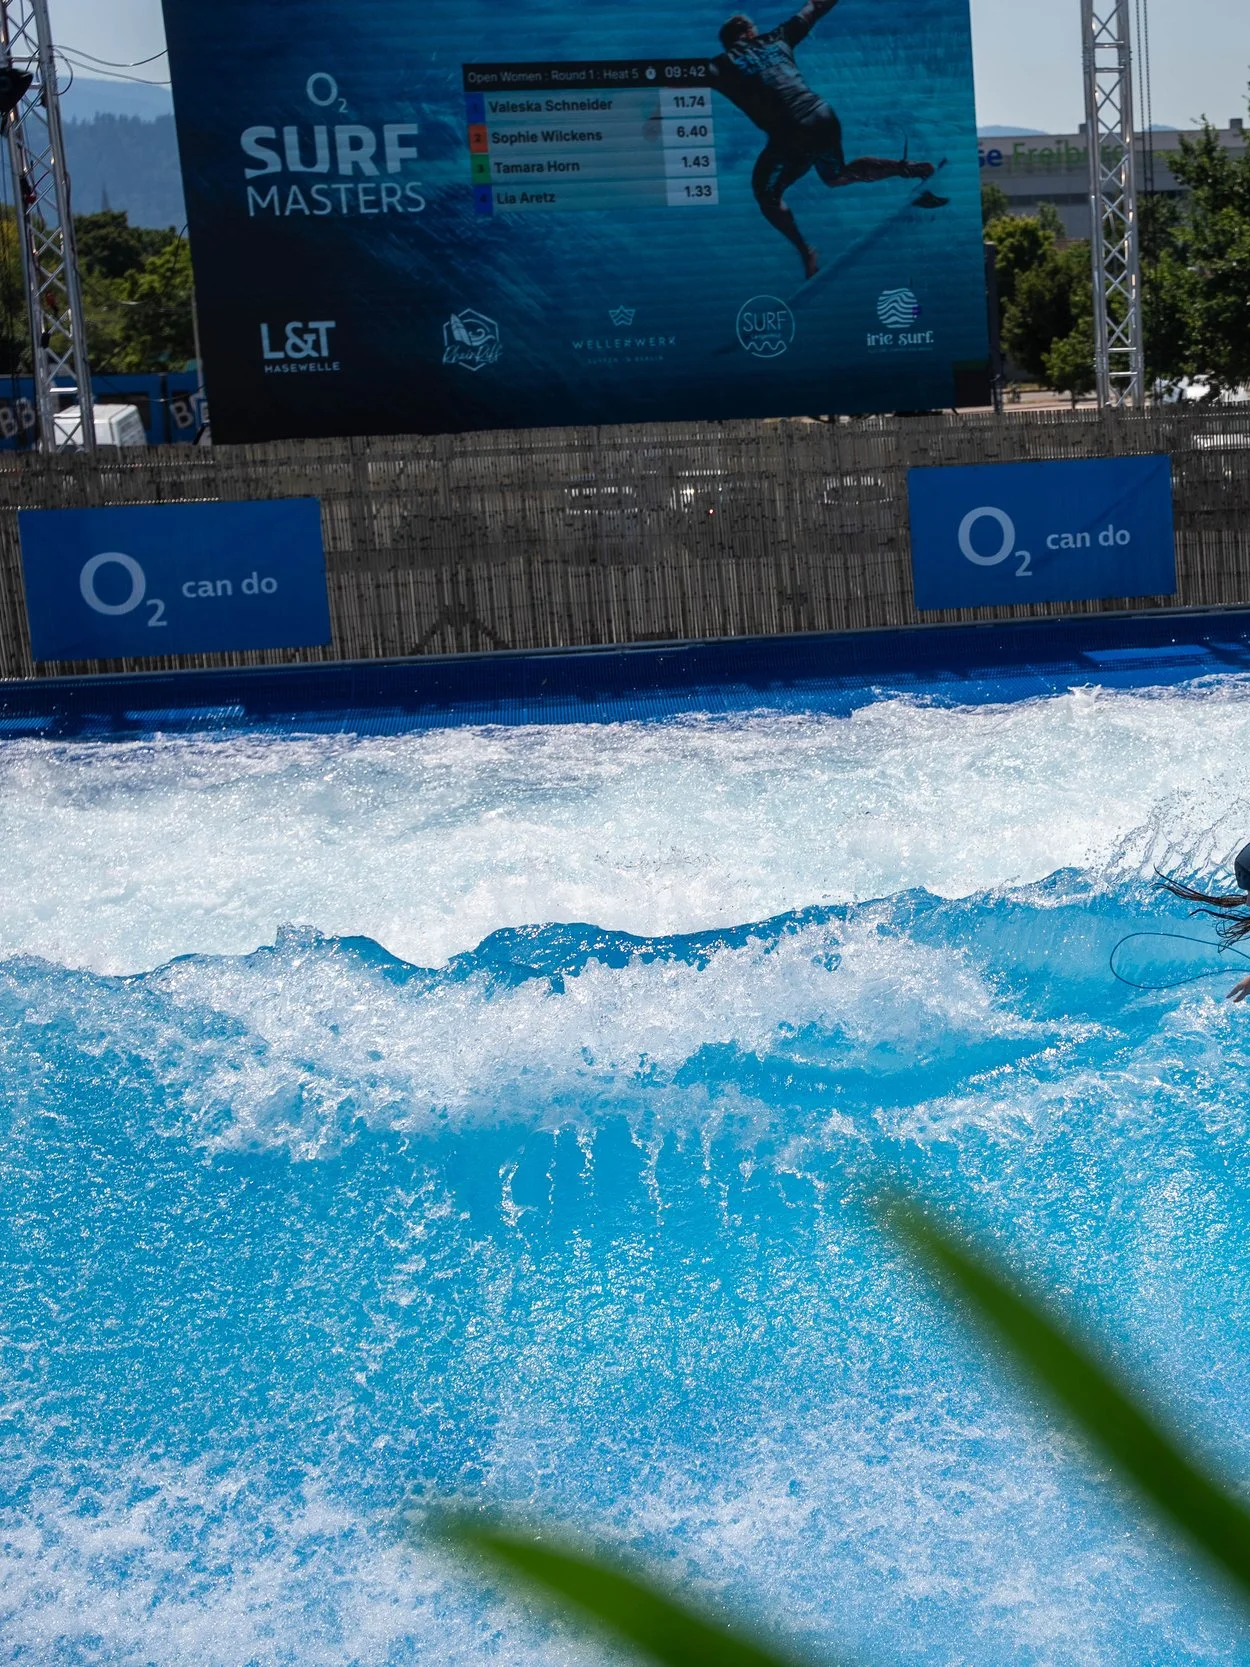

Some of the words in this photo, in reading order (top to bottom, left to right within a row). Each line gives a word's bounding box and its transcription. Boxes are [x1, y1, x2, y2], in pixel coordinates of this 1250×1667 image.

[467, 71, 498, 84] Open
[500, 70, 542, 82] Women
[551, 69, 587, 81] Round
[588, 69, 594, 80] 1
[603, 68, 629, 80] Heat
[631, 68, 639, 79] 5
[664, 65, 706, 79] 09:42
[488, 101, 542, 114] Valeska
[545, 99, 613, 112] Schneider
[673, 96, 706, 108] 11.74
[474, 133, 482, 143] 2
[491, 131, 538, 145] Sophie
[541, 130, 603, 143] Wilckens
[676, 126, 708, 138] 6.40
[240, 123, 419, 179] SURF
[1012, 140, 1123, 168] Freibrg
[494, 162, 544, 174] Tamara
[547, 160, 580, 173] Horn
[681, 156, 710, 168] 1.43
[247, 182, 426, 217] MASTERS
[497, 192, 517, 205] Lia
[520, 191, 556, 204] Aretz
[684, 185, 712, 198] 1.33
[743, 310, 787, 332] SURF
[260, 320, 336, 360] L&T
[866, 333, 894, 346] irie
[264, 362, 341, 374] HASEWELLE
[1046, 531, 1091, 550] can
[1098, 524, 1131, 546] do
[182, 579, 233, 599] can
[241, 572, 278, 595] do
